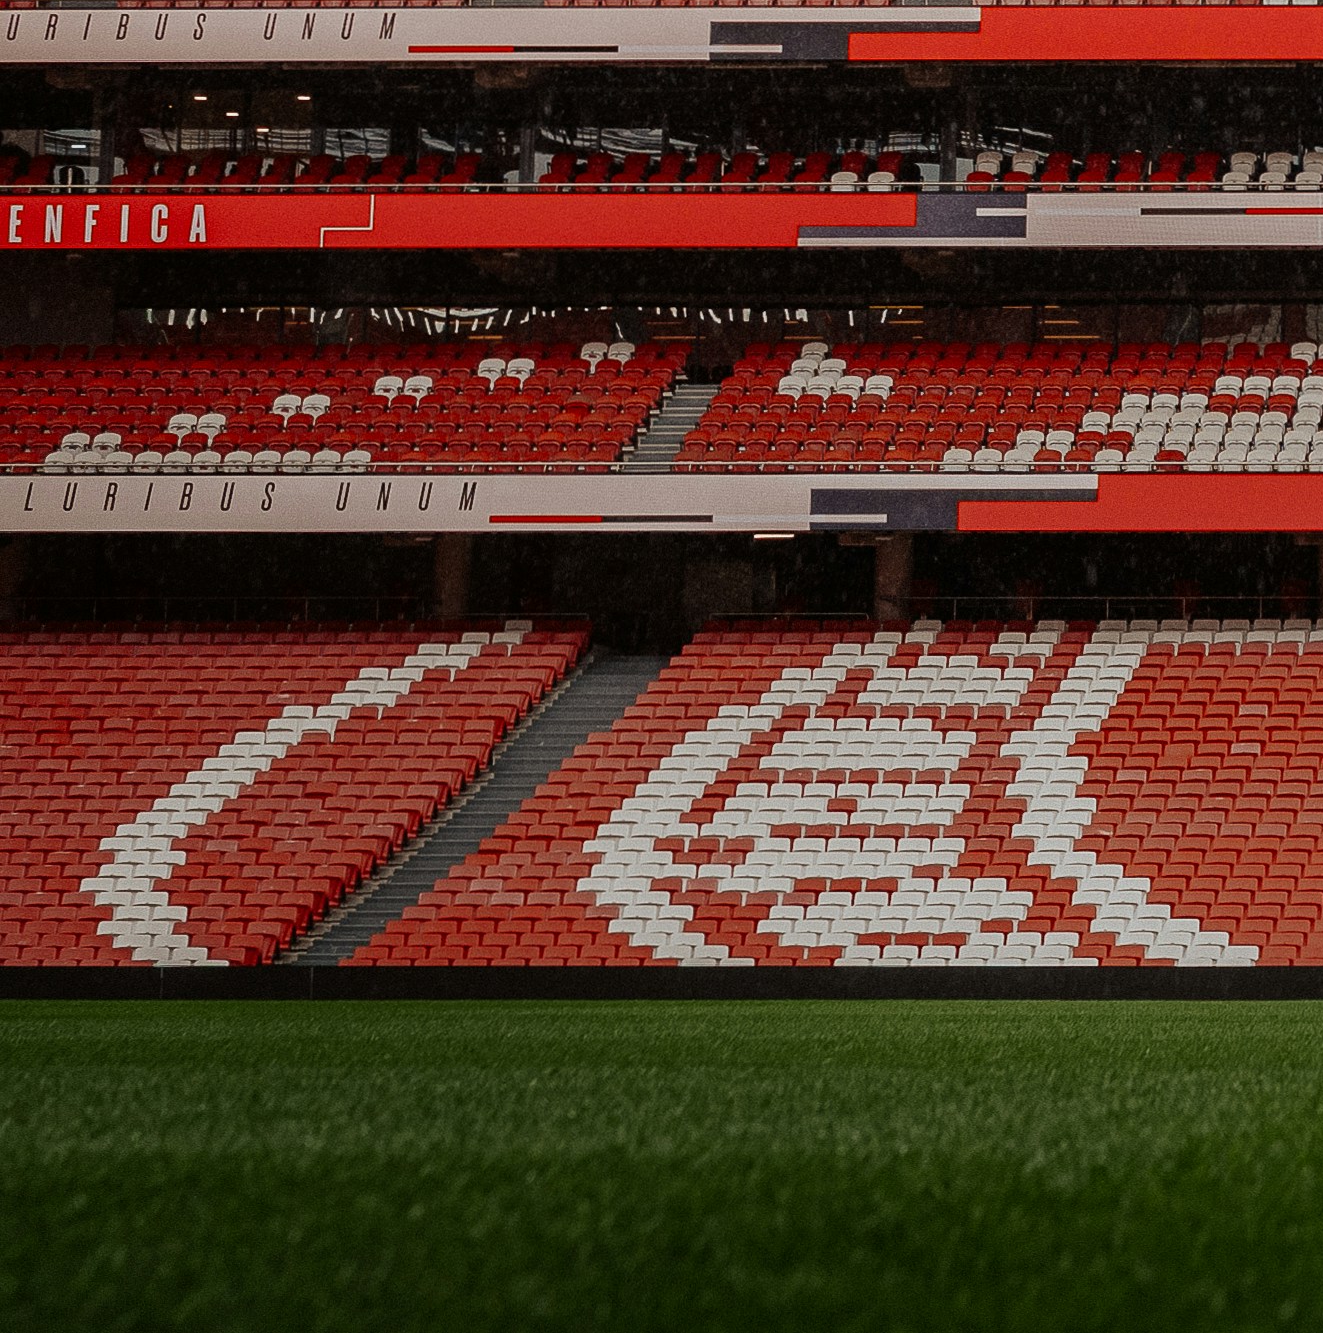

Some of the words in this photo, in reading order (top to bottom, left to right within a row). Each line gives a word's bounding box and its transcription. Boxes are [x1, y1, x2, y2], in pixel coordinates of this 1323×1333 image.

[6, 12, 206, 41] URIBUS
[263, 12, 396, 41] UNUM
[8, 204, 207, 243] ENFICA
[23, 481, 276, 512] LURIBUS
[335, 481, 477, 512] UNUM
